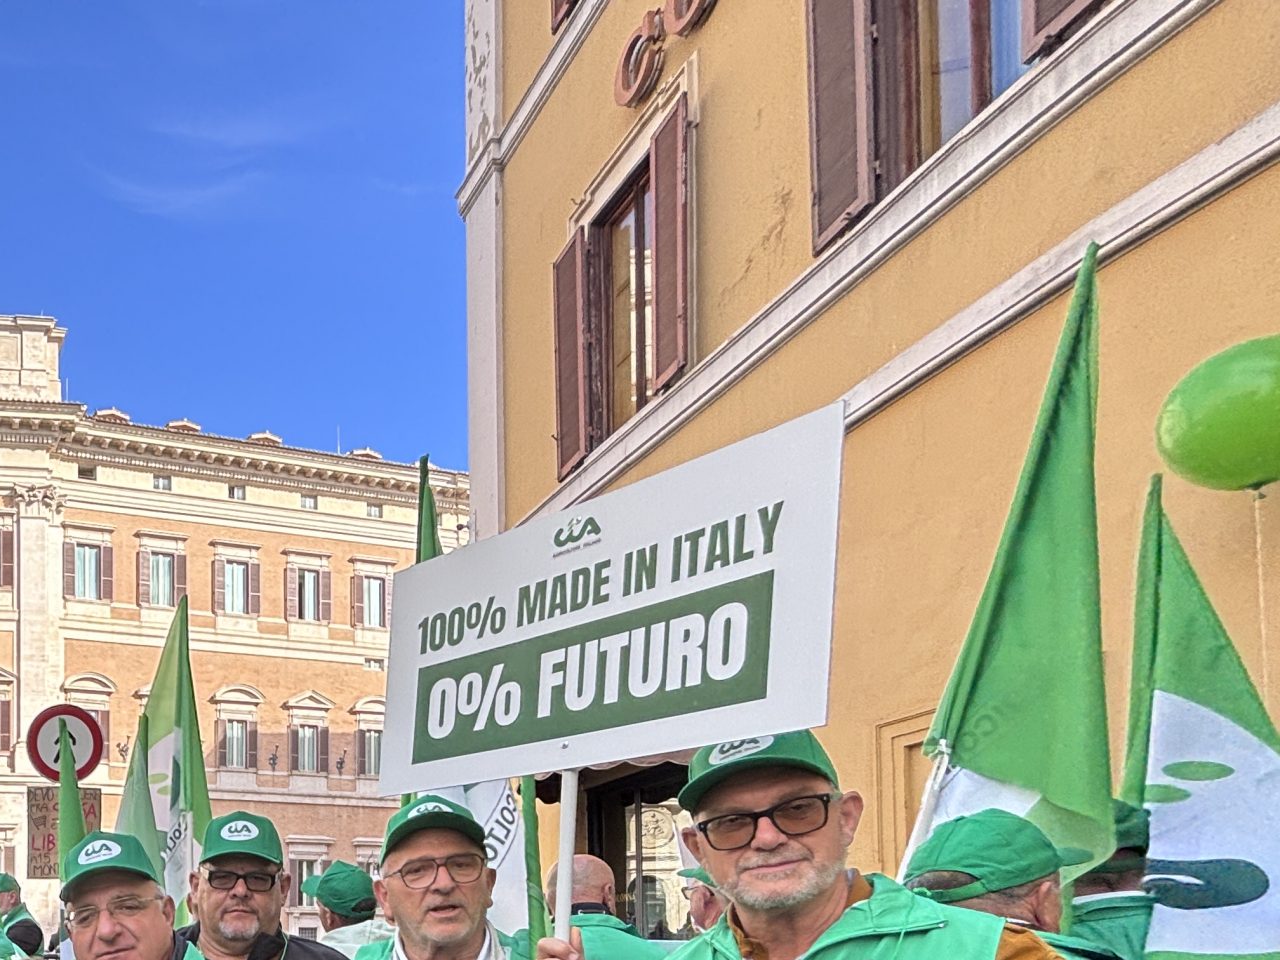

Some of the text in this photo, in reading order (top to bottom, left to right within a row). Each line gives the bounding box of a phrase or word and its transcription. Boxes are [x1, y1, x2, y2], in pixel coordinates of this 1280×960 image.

[418, 500, 784, 655] 100% MADE IN ITALY
[427, 602, 748, 739] 0% FUTURO
